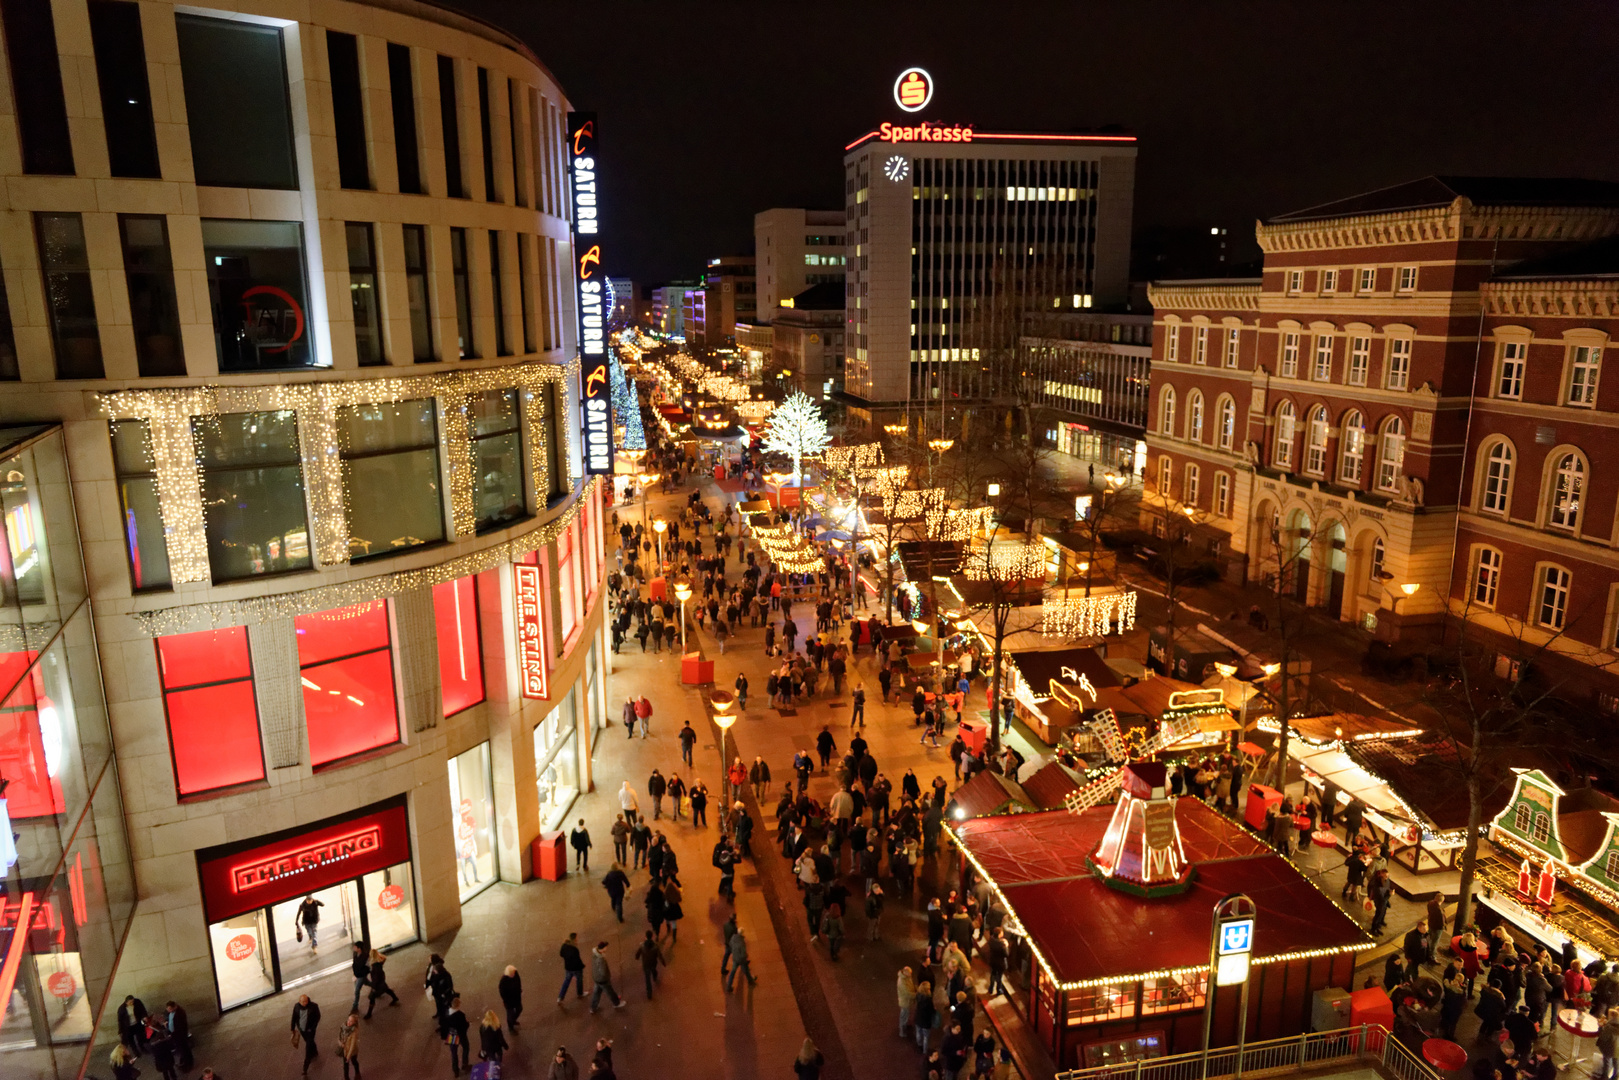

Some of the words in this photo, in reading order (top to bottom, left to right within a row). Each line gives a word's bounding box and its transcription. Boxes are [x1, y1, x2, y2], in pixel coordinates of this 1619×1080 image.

[880, 122, 973, 144] Sparkasse
[574, 157, 598, 234] SATURN
[580, 281, 604, 354] SATURN
[587, 399, 610, 469] SATURN
[521, 572, 537, 616] THE
[526, 622, 542, 692] STING
[238, 857, 292, 884] THE
[297, 833, 374, 869] STING
